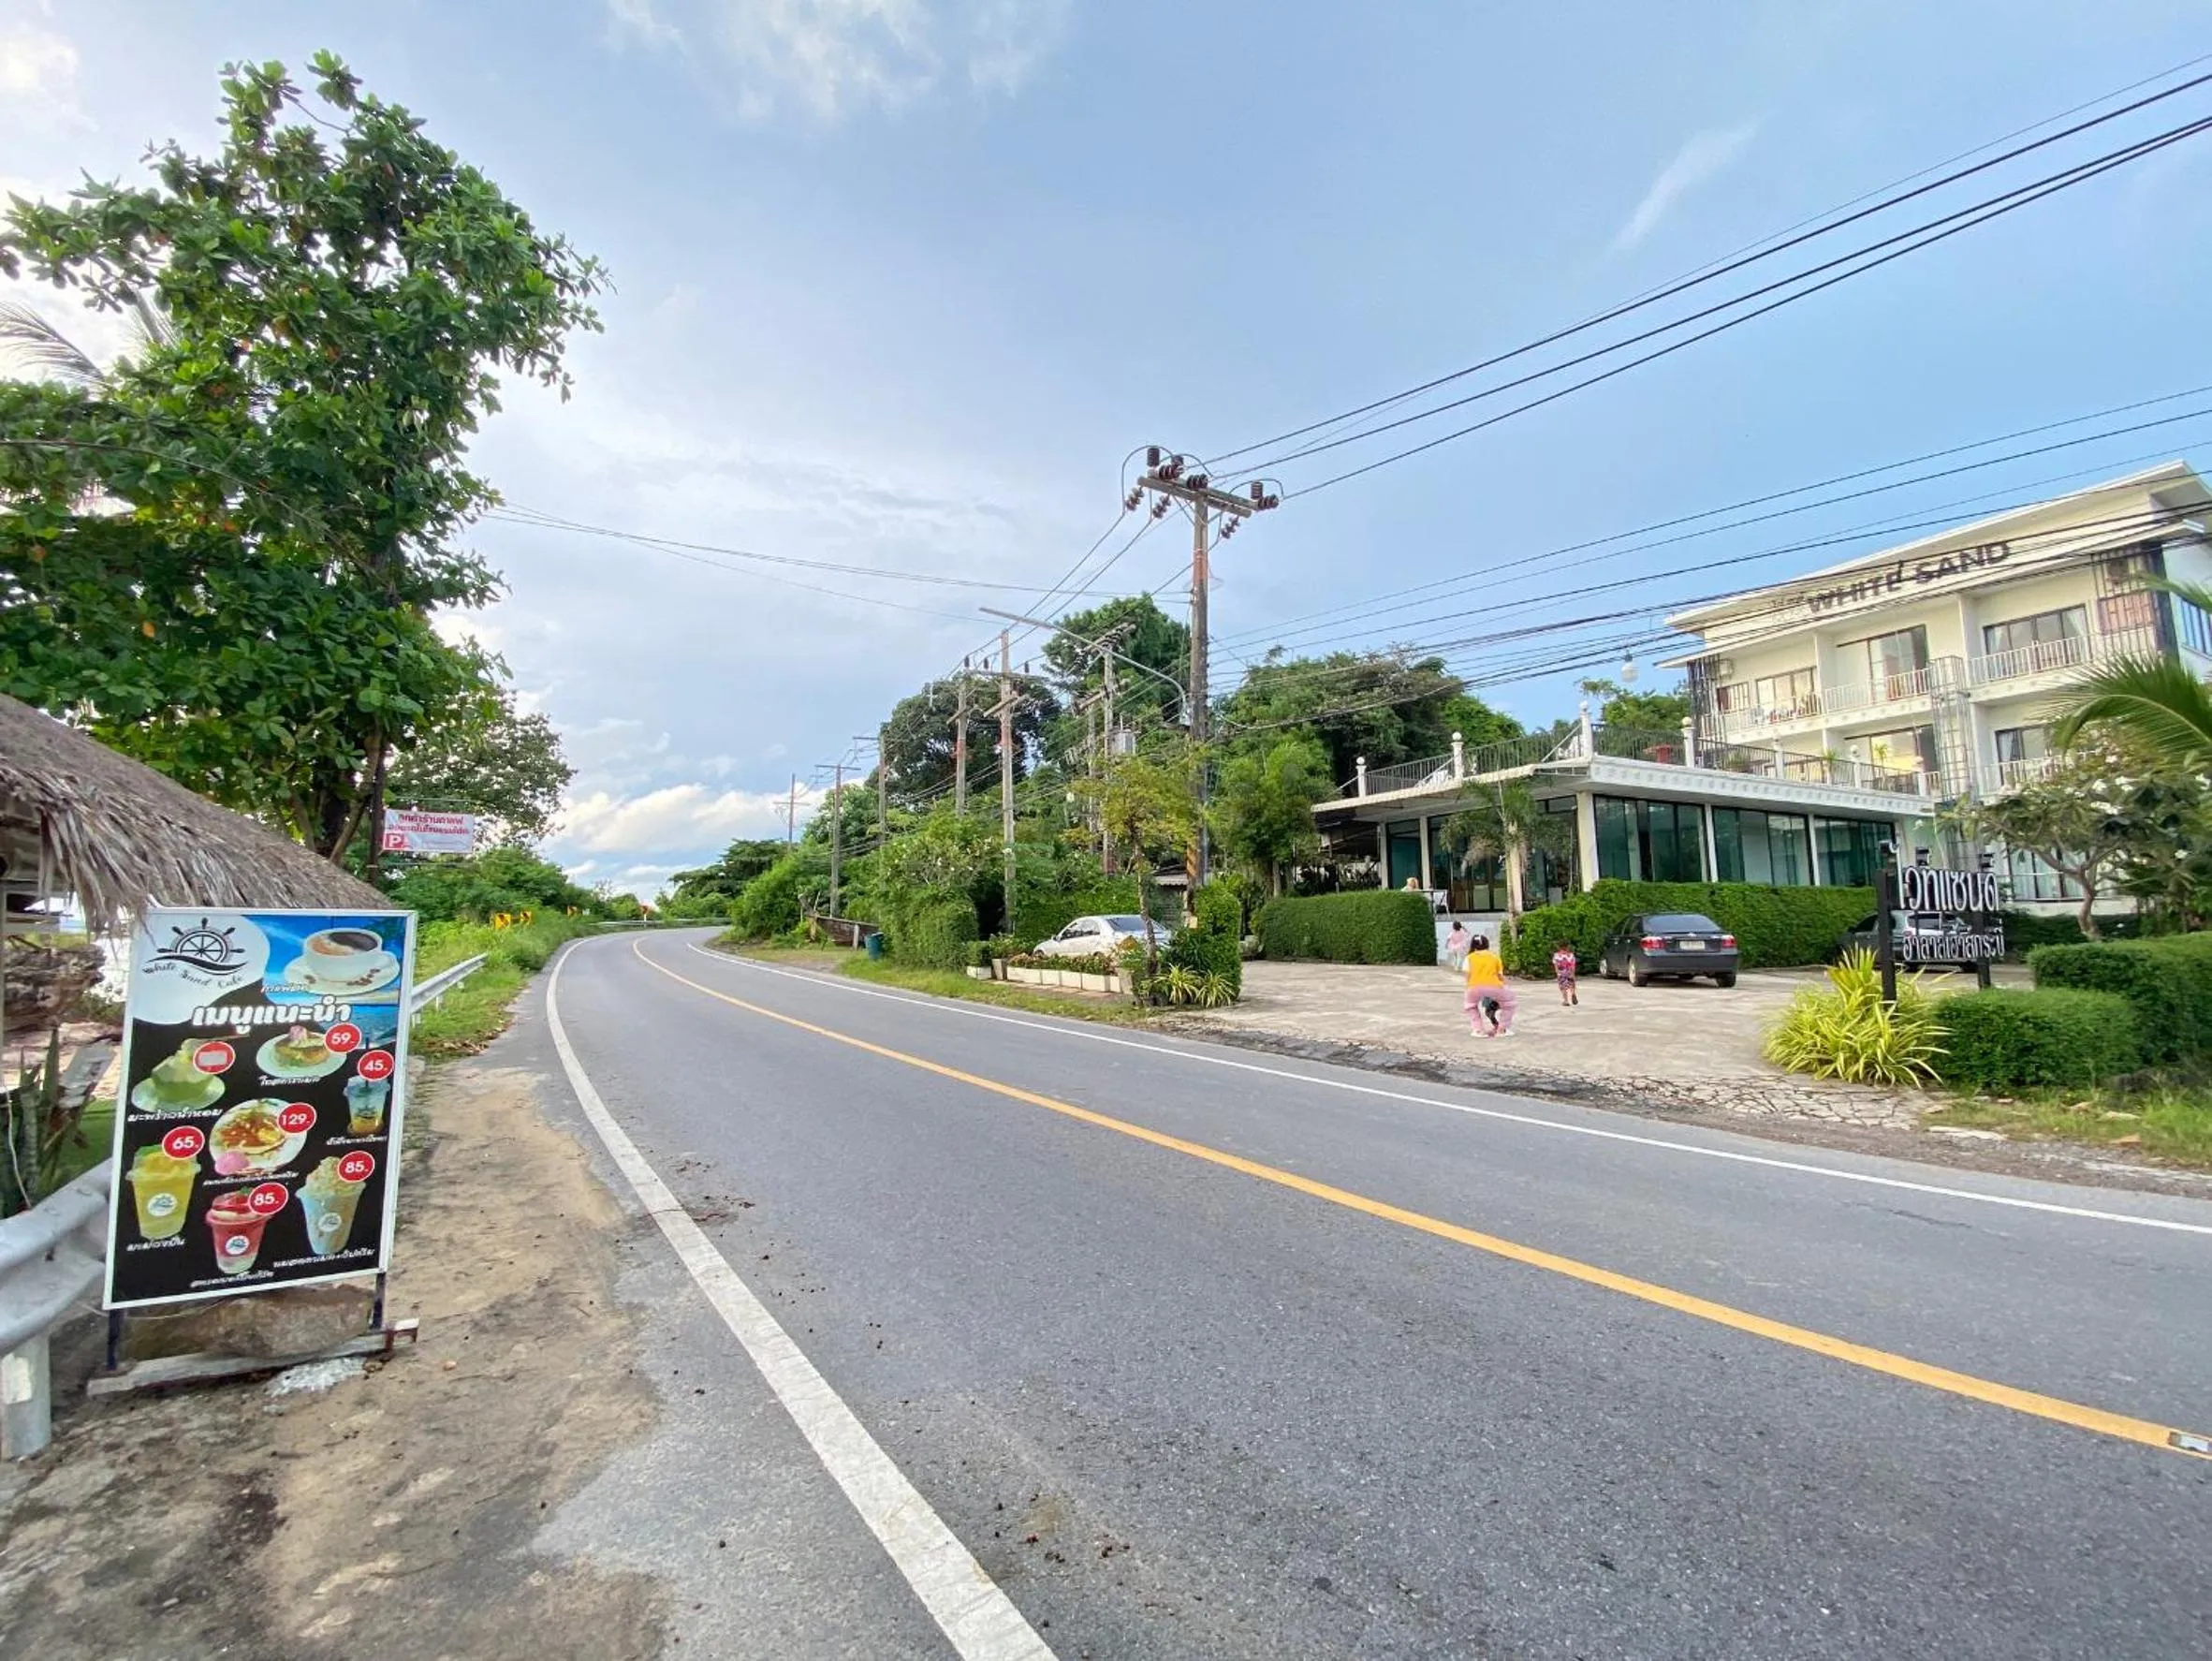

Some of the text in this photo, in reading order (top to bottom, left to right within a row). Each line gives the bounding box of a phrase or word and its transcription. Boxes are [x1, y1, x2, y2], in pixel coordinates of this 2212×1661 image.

[1807, 571, 1902, 613] WHITE
[1916, 541, 2010, 583] SAND
[192, 995, 352, 1035] เมนูแนะนำ
